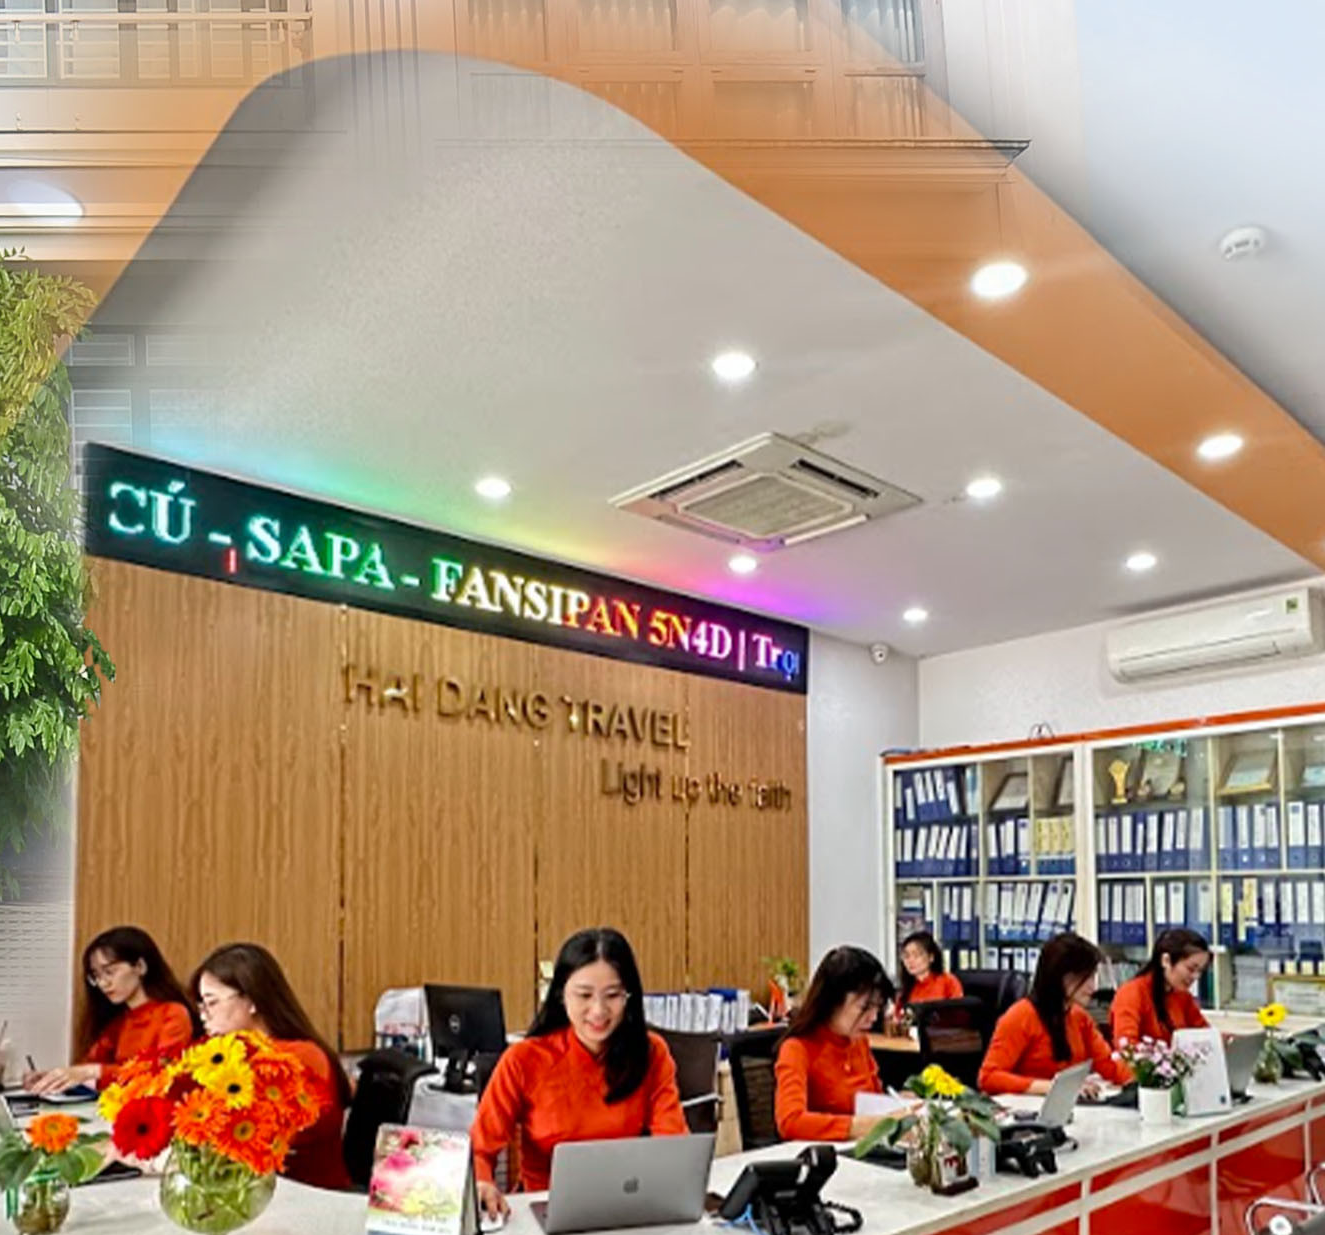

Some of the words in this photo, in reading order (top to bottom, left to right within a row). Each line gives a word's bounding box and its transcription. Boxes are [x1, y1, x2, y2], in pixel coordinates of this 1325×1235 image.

[246, 515, 395, 591] SAPA
[432, 558, 641, 640] FANSIPAN
[649, 611, 732, 660] 5N4D
[752, 634, 800, 681] Trọ
[341, 664, 420, 716] HAI
[437, 677, 552, 730] DANG
[560, 695, 691, 750] TRAVEL
[601, 759, 661, 806] Light
